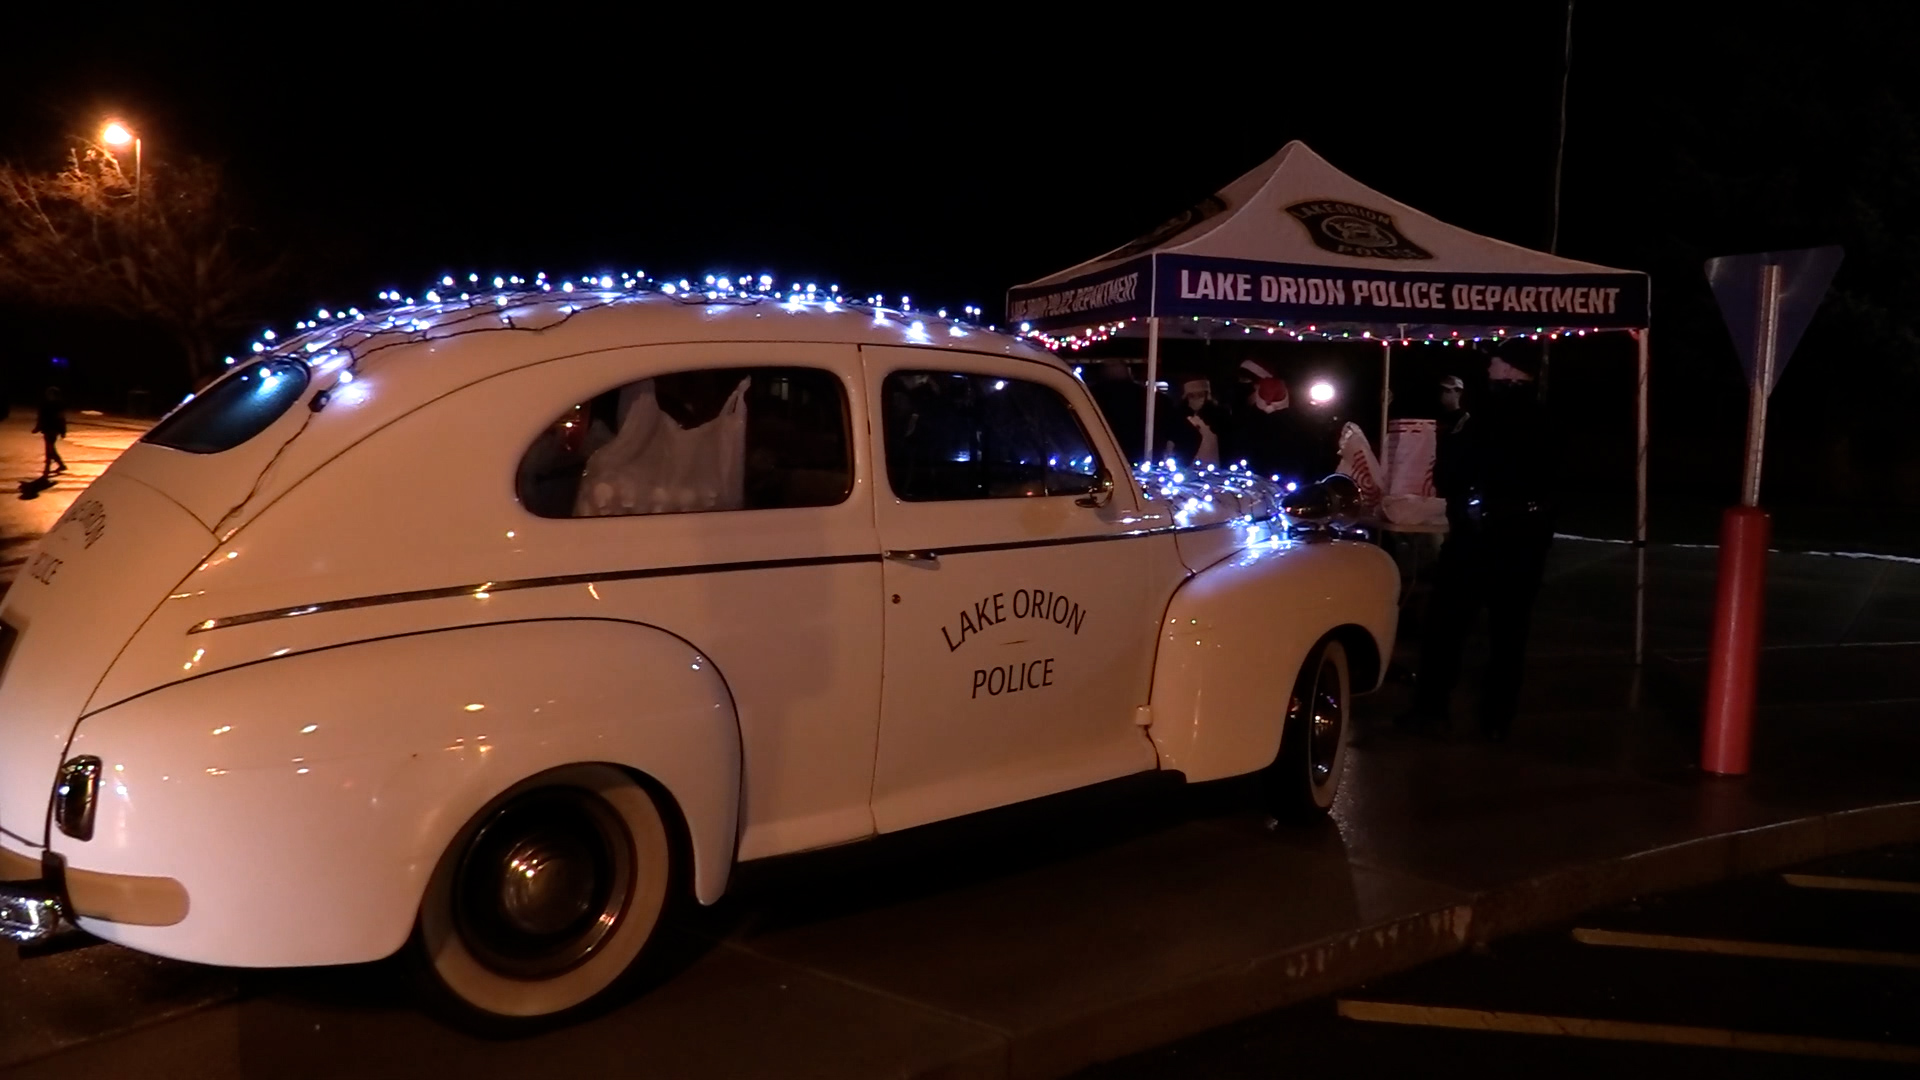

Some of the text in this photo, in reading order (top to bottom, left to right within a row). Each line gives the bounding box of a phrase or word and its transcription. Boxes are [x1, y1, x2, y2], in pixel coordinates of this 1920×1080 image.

[1072, 272, 1139, 313] DEPARTMENT
[1180, 269, 1621, 315] LAKE ORION POLICE DEPARTMENT
[941, 588, 1087, 652] LAKE ORION
[971, 657, 1055, 699] POLICE
